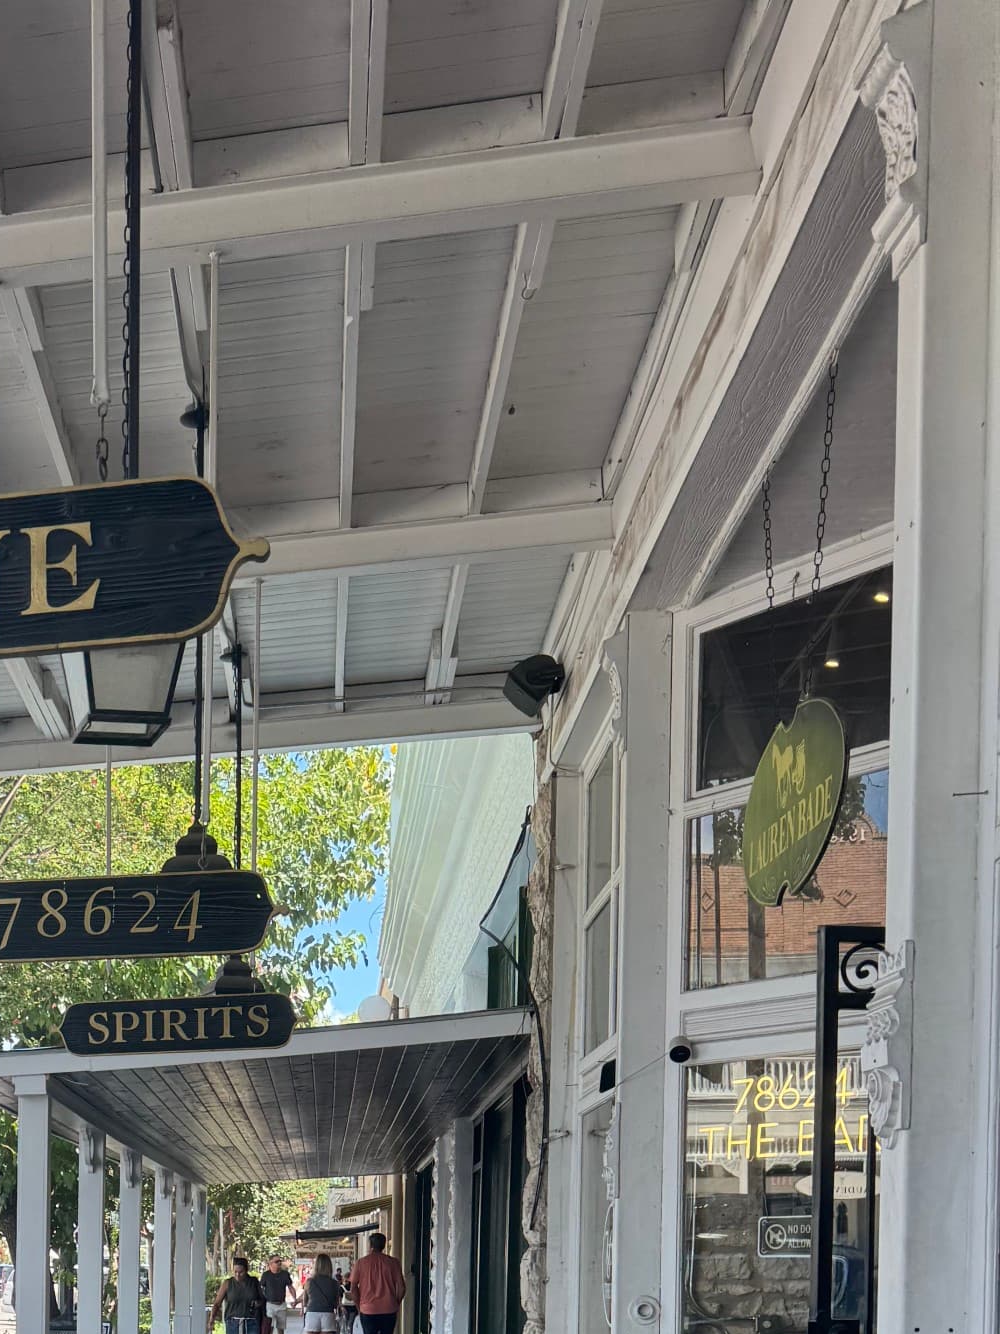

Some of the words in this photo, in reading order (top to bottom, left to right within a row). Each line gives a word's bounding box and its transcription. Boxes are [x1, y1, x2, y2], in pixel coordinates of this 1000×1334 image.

[749, 806, 796, 878] LAUREN
[798, 774, 834, 840] BADE
[88, 1004, 269, 1045] SPIRITS
[699, 1122, 779, 1161] THE
[787, 1224, 798, 1234] NO
[800, 1224, 811, 1234] DO
